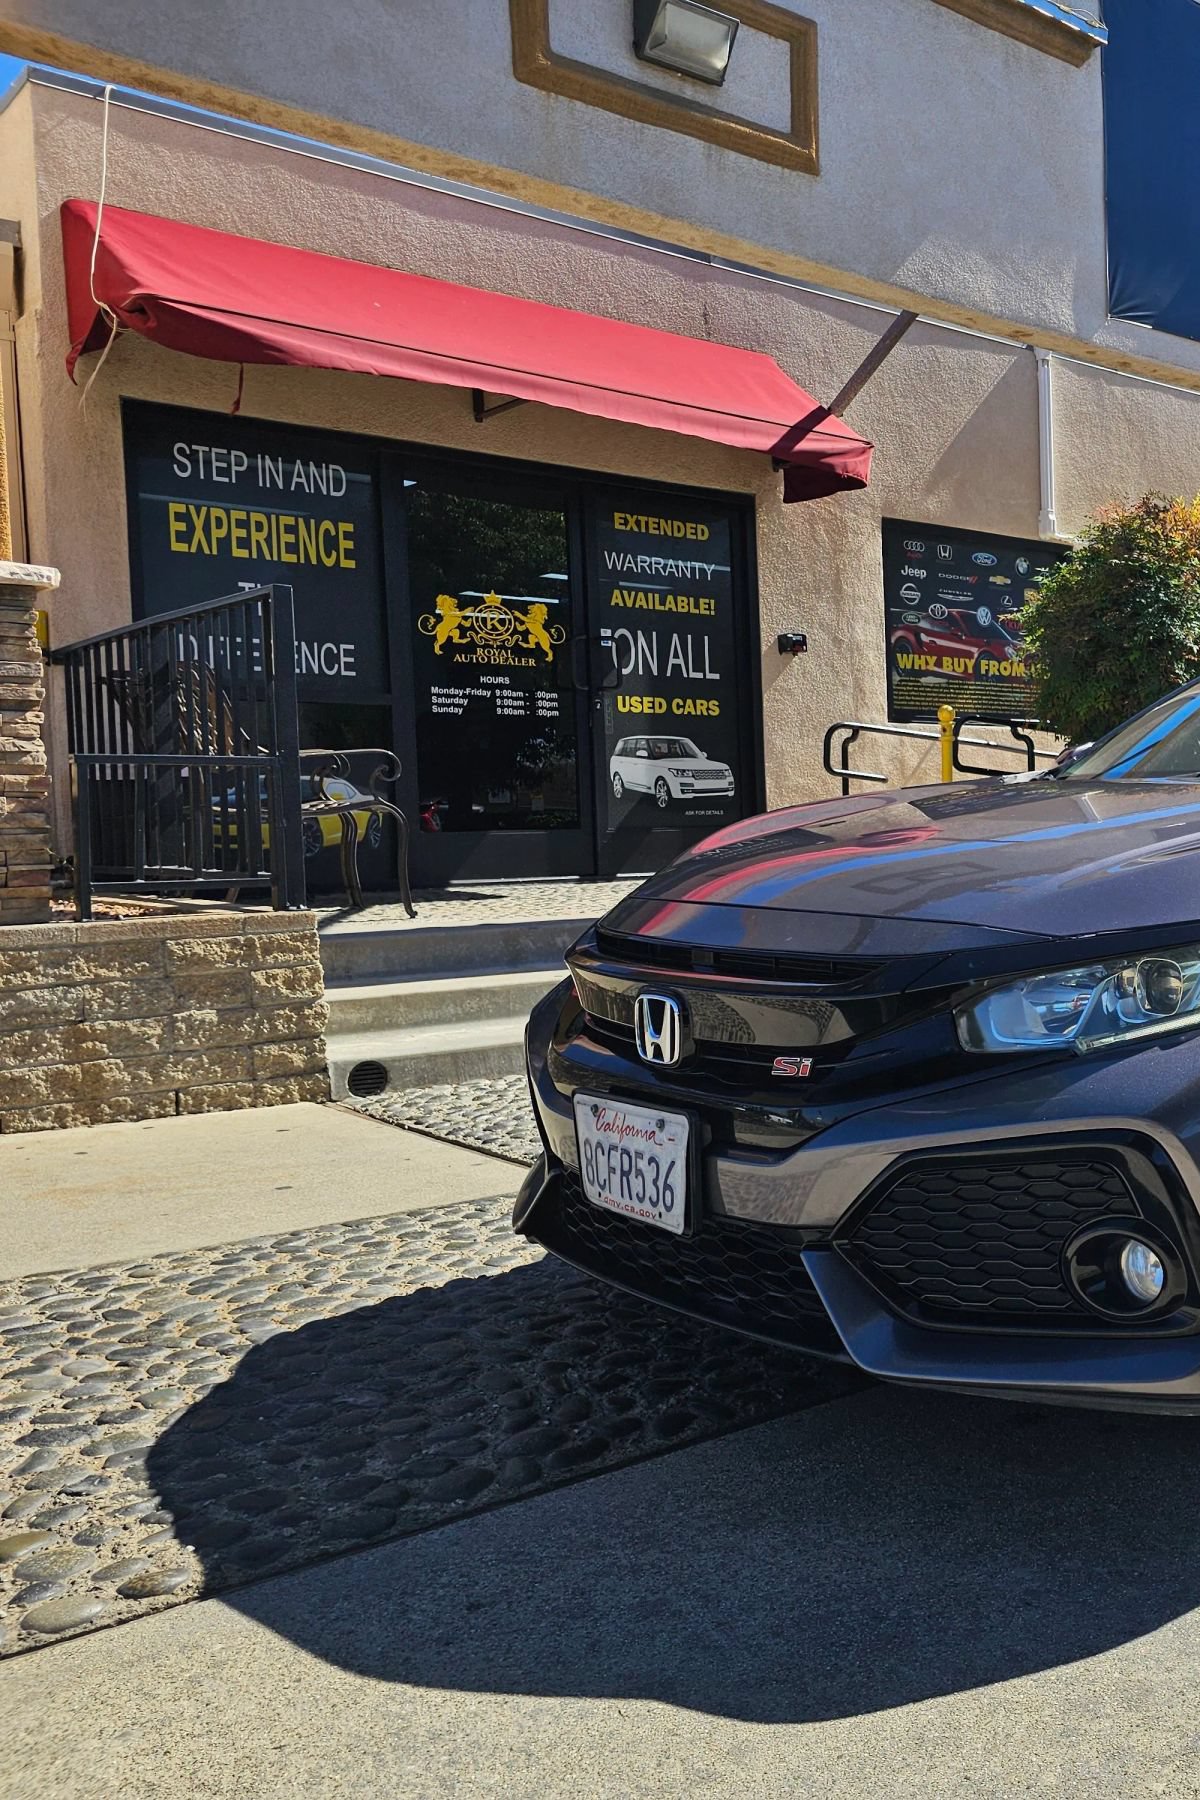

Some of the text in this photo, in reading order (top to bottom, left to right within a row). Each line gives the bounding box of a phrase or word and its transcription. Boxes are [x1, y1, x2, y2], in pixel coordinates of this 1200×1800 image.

[172, 442, 347, 497] STEP IN AND
[168, 502, 356, 569] EXPERIENCE
[613, 512, 710, 541] EXTENDED
[604, 550, 716, 581] WARRANTY
[901, 565, 927, 580] Jeep
[610, 589, 716, 616] AVAILABLE!
[453, 653, 537, 667] AUTO DEALER
[476, 647, 514, 658] ROYAL
[612, 627, 720, 679] ON ALL
[897, 652, 1026, 678] WHY BUY FROM
[431, 686, 492, 698] Monday-Friday
[495, 689, 524, 698] 9:00am
[480, 676, 510, 685] HOURS
[431, 695, 469, 706] Saturday
[496, 698, 525, 707] 9:00am
[432, 705, 464, 715] Sunday
[496, 707, 525, 716] 9:00am
[616, 695, 667, 715] USED
[671, 698, 720, 717] CARS
[771, 1056, 814, 1077] Si
[595, 1107, 664, 1146] California
[584, 1137, 676, 1213] 8CFR536
[603, 1196, 657, 1220] dmv.ca.gov
